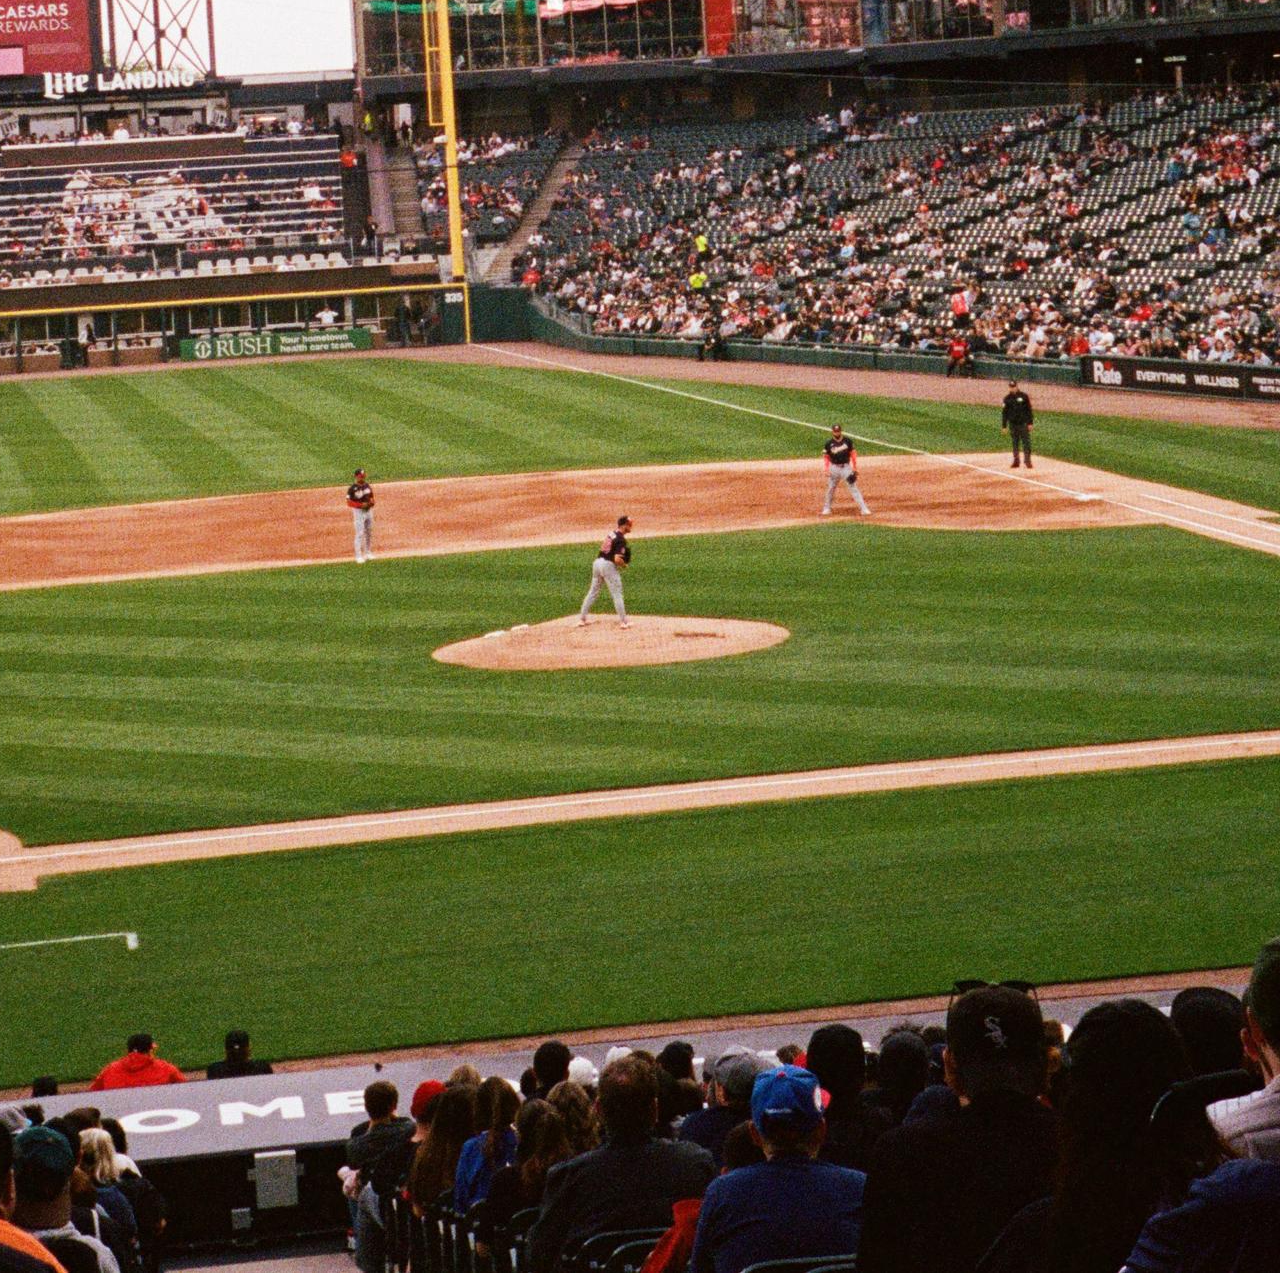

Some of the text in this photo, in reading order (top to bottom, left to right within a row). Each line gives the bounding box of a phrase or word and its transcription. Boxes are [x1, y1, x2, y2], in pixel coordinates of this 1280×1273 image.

[42, 71, 196, 101] Lite LANDING
[444, 292, 464, 303] 335
[215, 336, 271, 358] RUSH
[279, 332, 349, 344] Your hometown
[279, 343, 308, 353] health
[309, 342, 329, 352] care
[1092, 361, 1123, 385] Rate
[1135, 370, 1187, 386] EVERYTHING
[1193, 375, 1240, 388] WELLNESS
